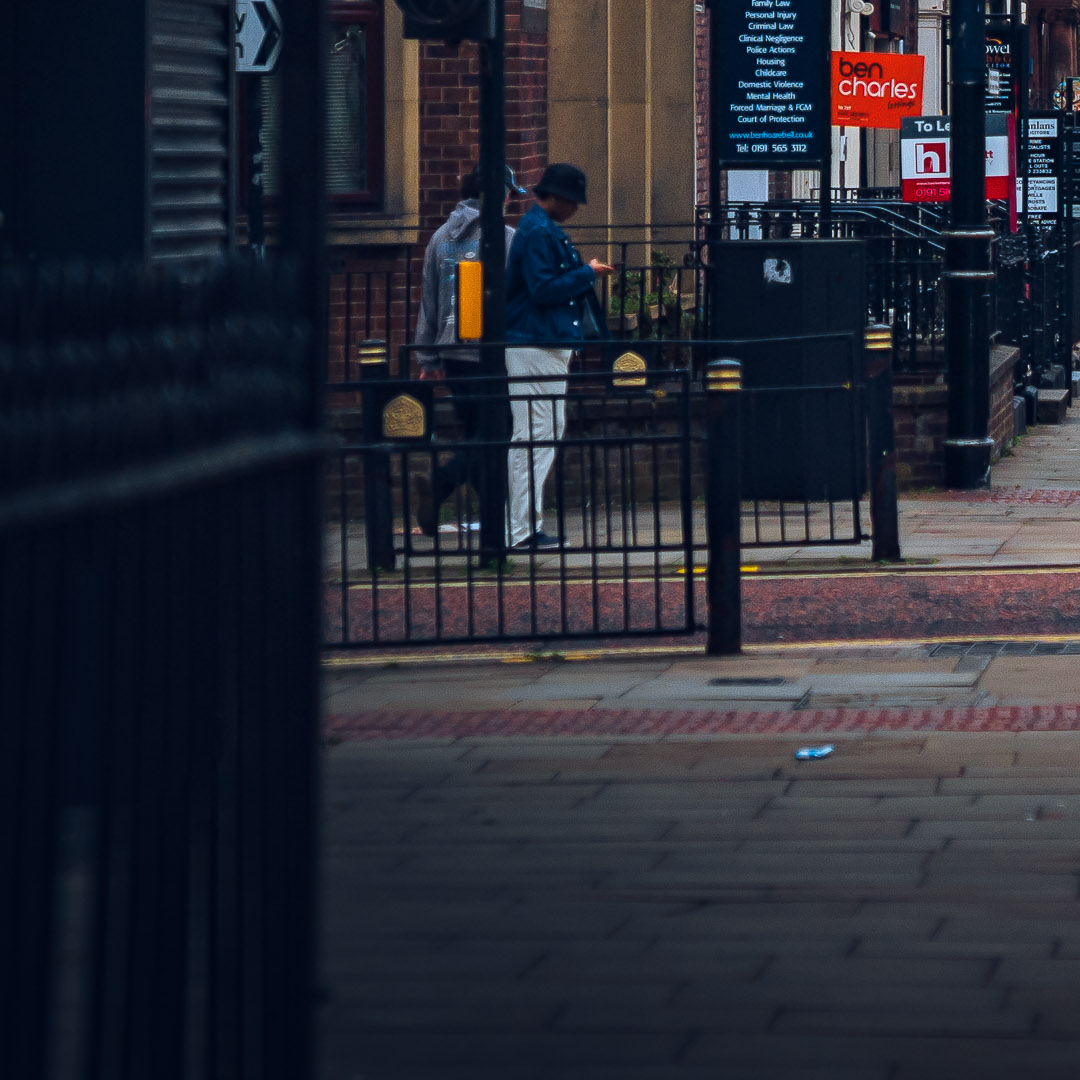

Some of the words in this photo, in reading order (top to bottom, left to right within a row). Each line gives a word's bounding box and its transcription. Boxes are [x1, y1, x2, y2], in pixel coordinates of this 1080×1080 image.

[751, 0, 774, 8] Family
[775, 0, 791, 7] Law
[744, 11, 775, 19] Personal
[777, 11, 797, 20] Injury
[748, 22, 777, 30] Criminal
[778, 22, 794, 30] Law
[738, 34, 764, 42] Clinical
[765, 34, 804, 44] Negligence
[746, 46, 767, 54] Police
[768, 46, 796, 54] Actions
[756, 58, 786, 67] Housing
[839, 57, 883, 79] ben
[755, 69, 787, 77] Childcare
[738, 80, 772, 89] Domestic
[773, 80, 804, 88] Violence
[838, 76, 918, 99] charles
[746, 92, 771, 100] Mental
[772, 92, 796, 100] Health
[730, 103, 754, 112] Forced
[755, 103, 786, 113] Marriage
[795, 103, 812, 111] FGM
[737, 115, 758, 123] Court
[759, 115, 767, 123] of
[769, 115, 805, 123] Protection
[914, 120, 933, 132] To
[936, 120, 951, 132] Le
[1028, 120, 1055, 130] nlans
[728, 131, 814, 139] www.benhoarebell.co.uk
[736, 143, 749, 153] Tel:
[751, 143, 768, 153] 0191
[771, 143, 788, 153] 565
[790, 143, 807, 153] 3112
[915, 188, 937, 197] 0191
